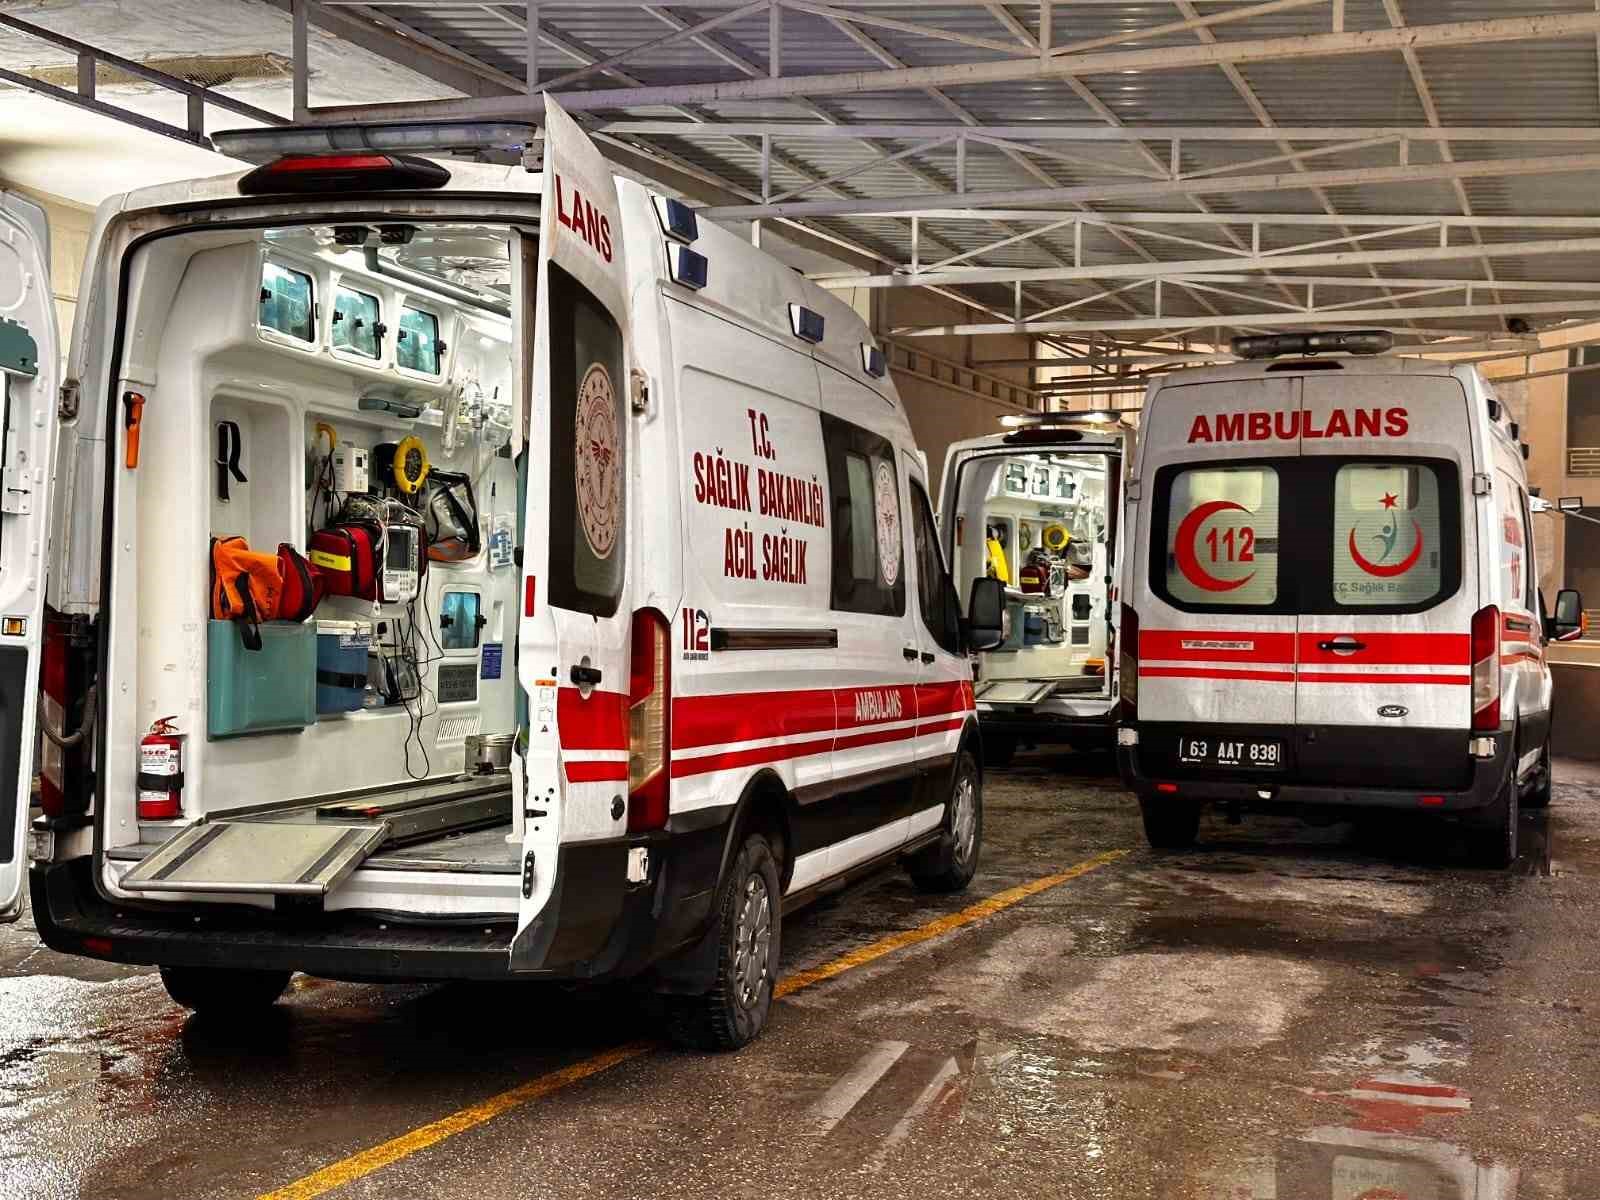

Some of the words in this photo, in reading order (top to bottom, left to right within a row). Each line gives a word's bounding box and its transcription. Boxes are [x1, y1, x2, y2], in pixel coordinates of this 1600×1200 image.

[555, 173, 612, 263] LANS
[748, 409, 775, 460] T.C.
[1187, 406, 1409, 443] AMBULANS
[693, 446, 751, 512] SAĞLIK
[757, 468, 824, 528] BAKANLIĞI
[724, 521, 757, 580] ACİL
[762, 526, 807, 585] SAĞLIK
[1206, 527, 1254, 562] 112
[854, 689, 902, 721] AMBULANS
[1190, 741, 1207, 757] 63
[1217, 742, 1244, 760] AAT
[1250, 744, 1276, 760] 838
